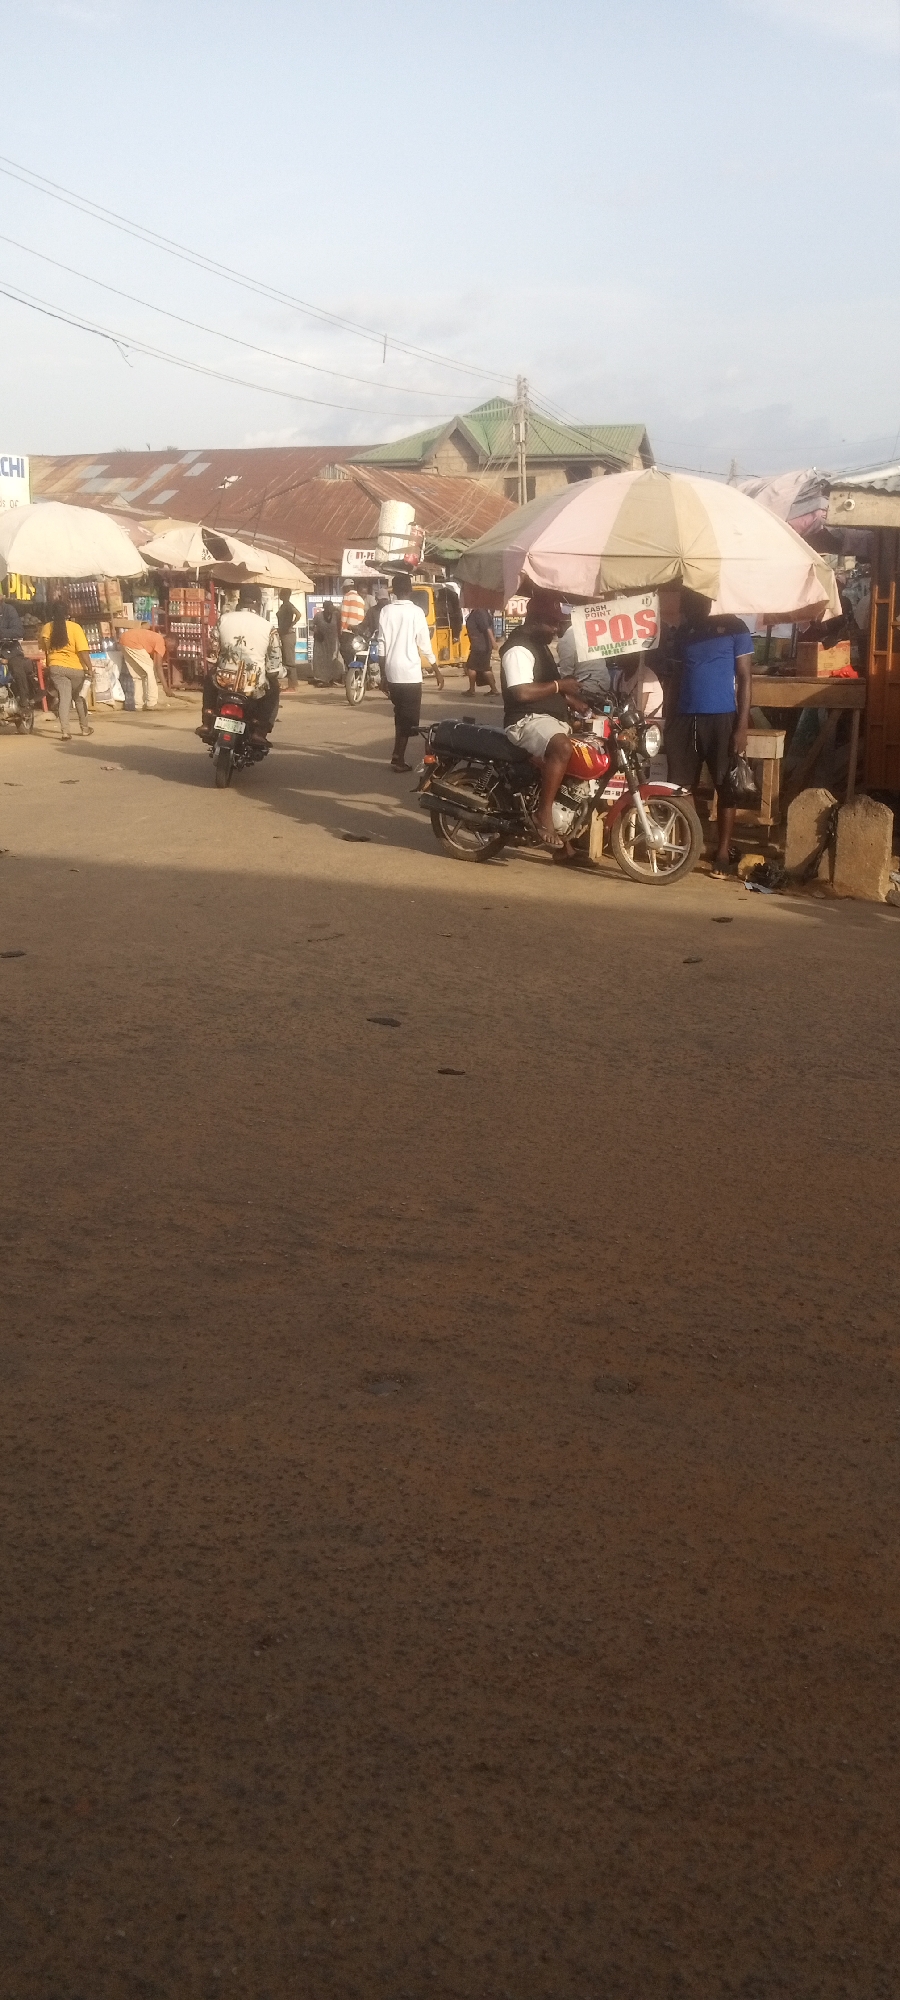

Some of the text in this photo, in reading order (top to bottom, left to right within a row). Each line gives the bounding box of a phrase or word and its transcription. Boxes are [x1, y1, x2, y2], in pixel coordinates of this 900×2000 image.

[0, 456, 25, 478] CHI
[584, 604, 607, 613] CASH
[585, 610, 611, 619] POINT
[585, 609, 657, 646] POS
[588, 638, 638, 653] AVAILABLE
[601, 646, 626, 656] HERE
